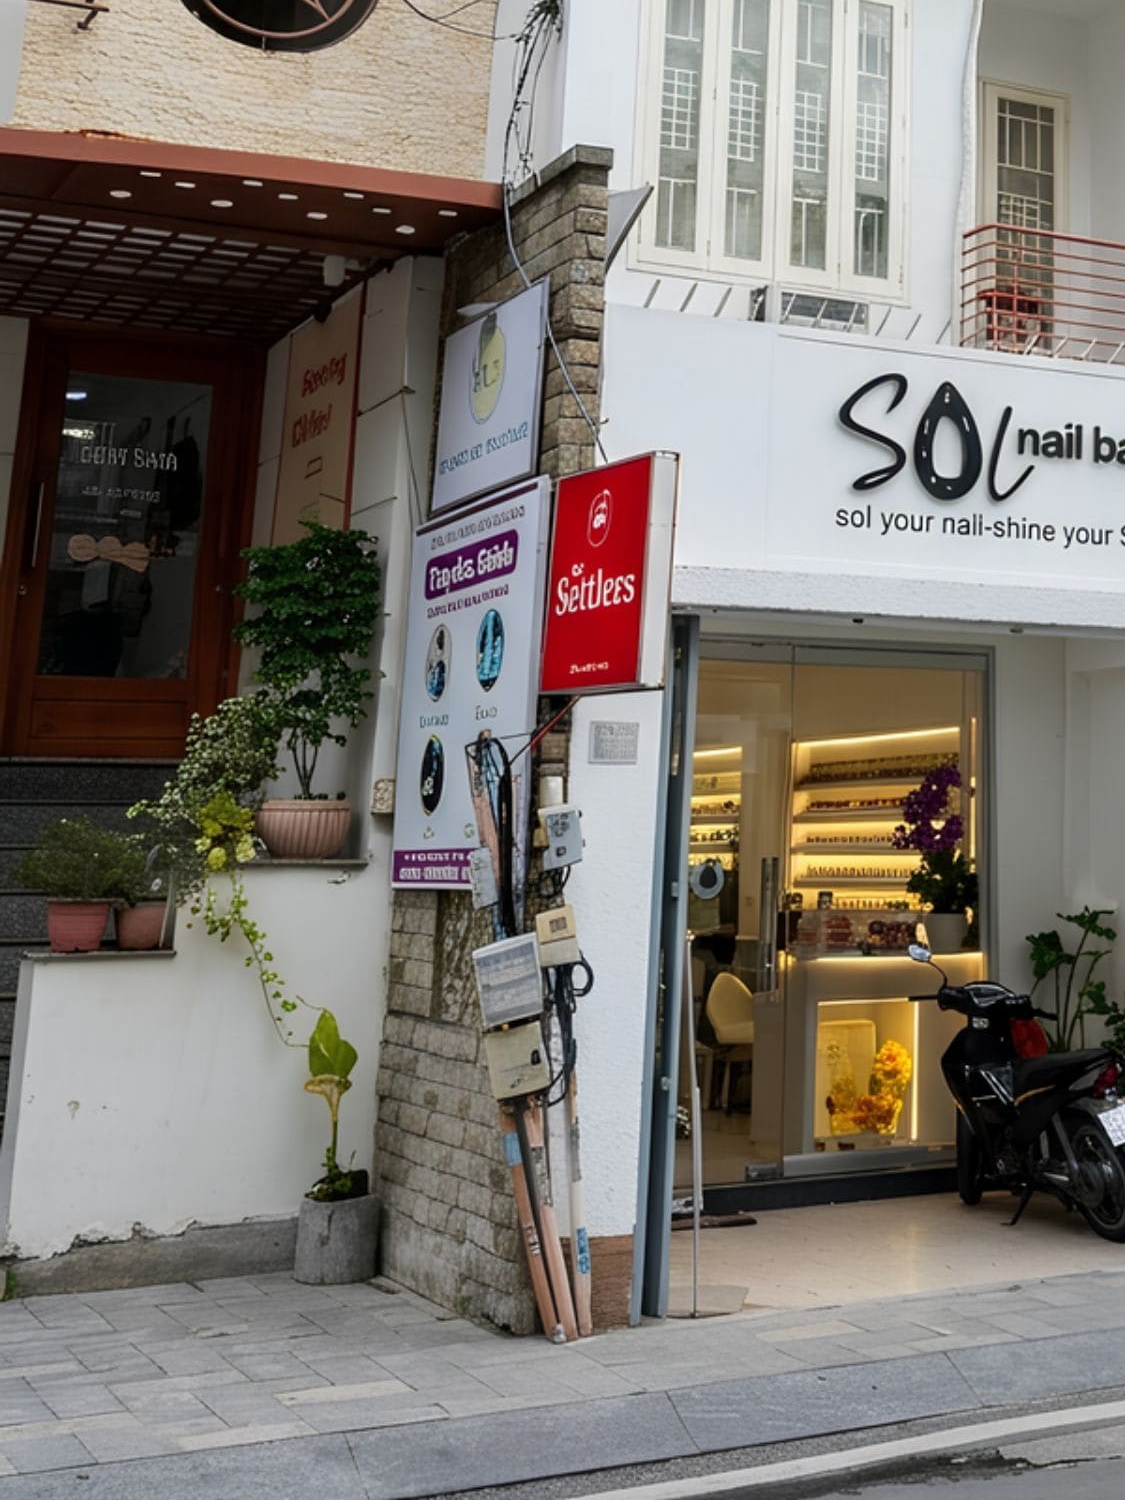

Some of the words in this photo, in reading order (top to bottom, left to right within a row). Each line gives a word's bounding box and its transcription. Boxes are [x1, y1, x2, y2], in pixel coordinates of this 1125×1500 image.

[1017, 423, 1083, 460] nail
[835, 505, 871, 529] sol
[880, 511, 935, 535] your
[1063, 524, 1114, 549] your
